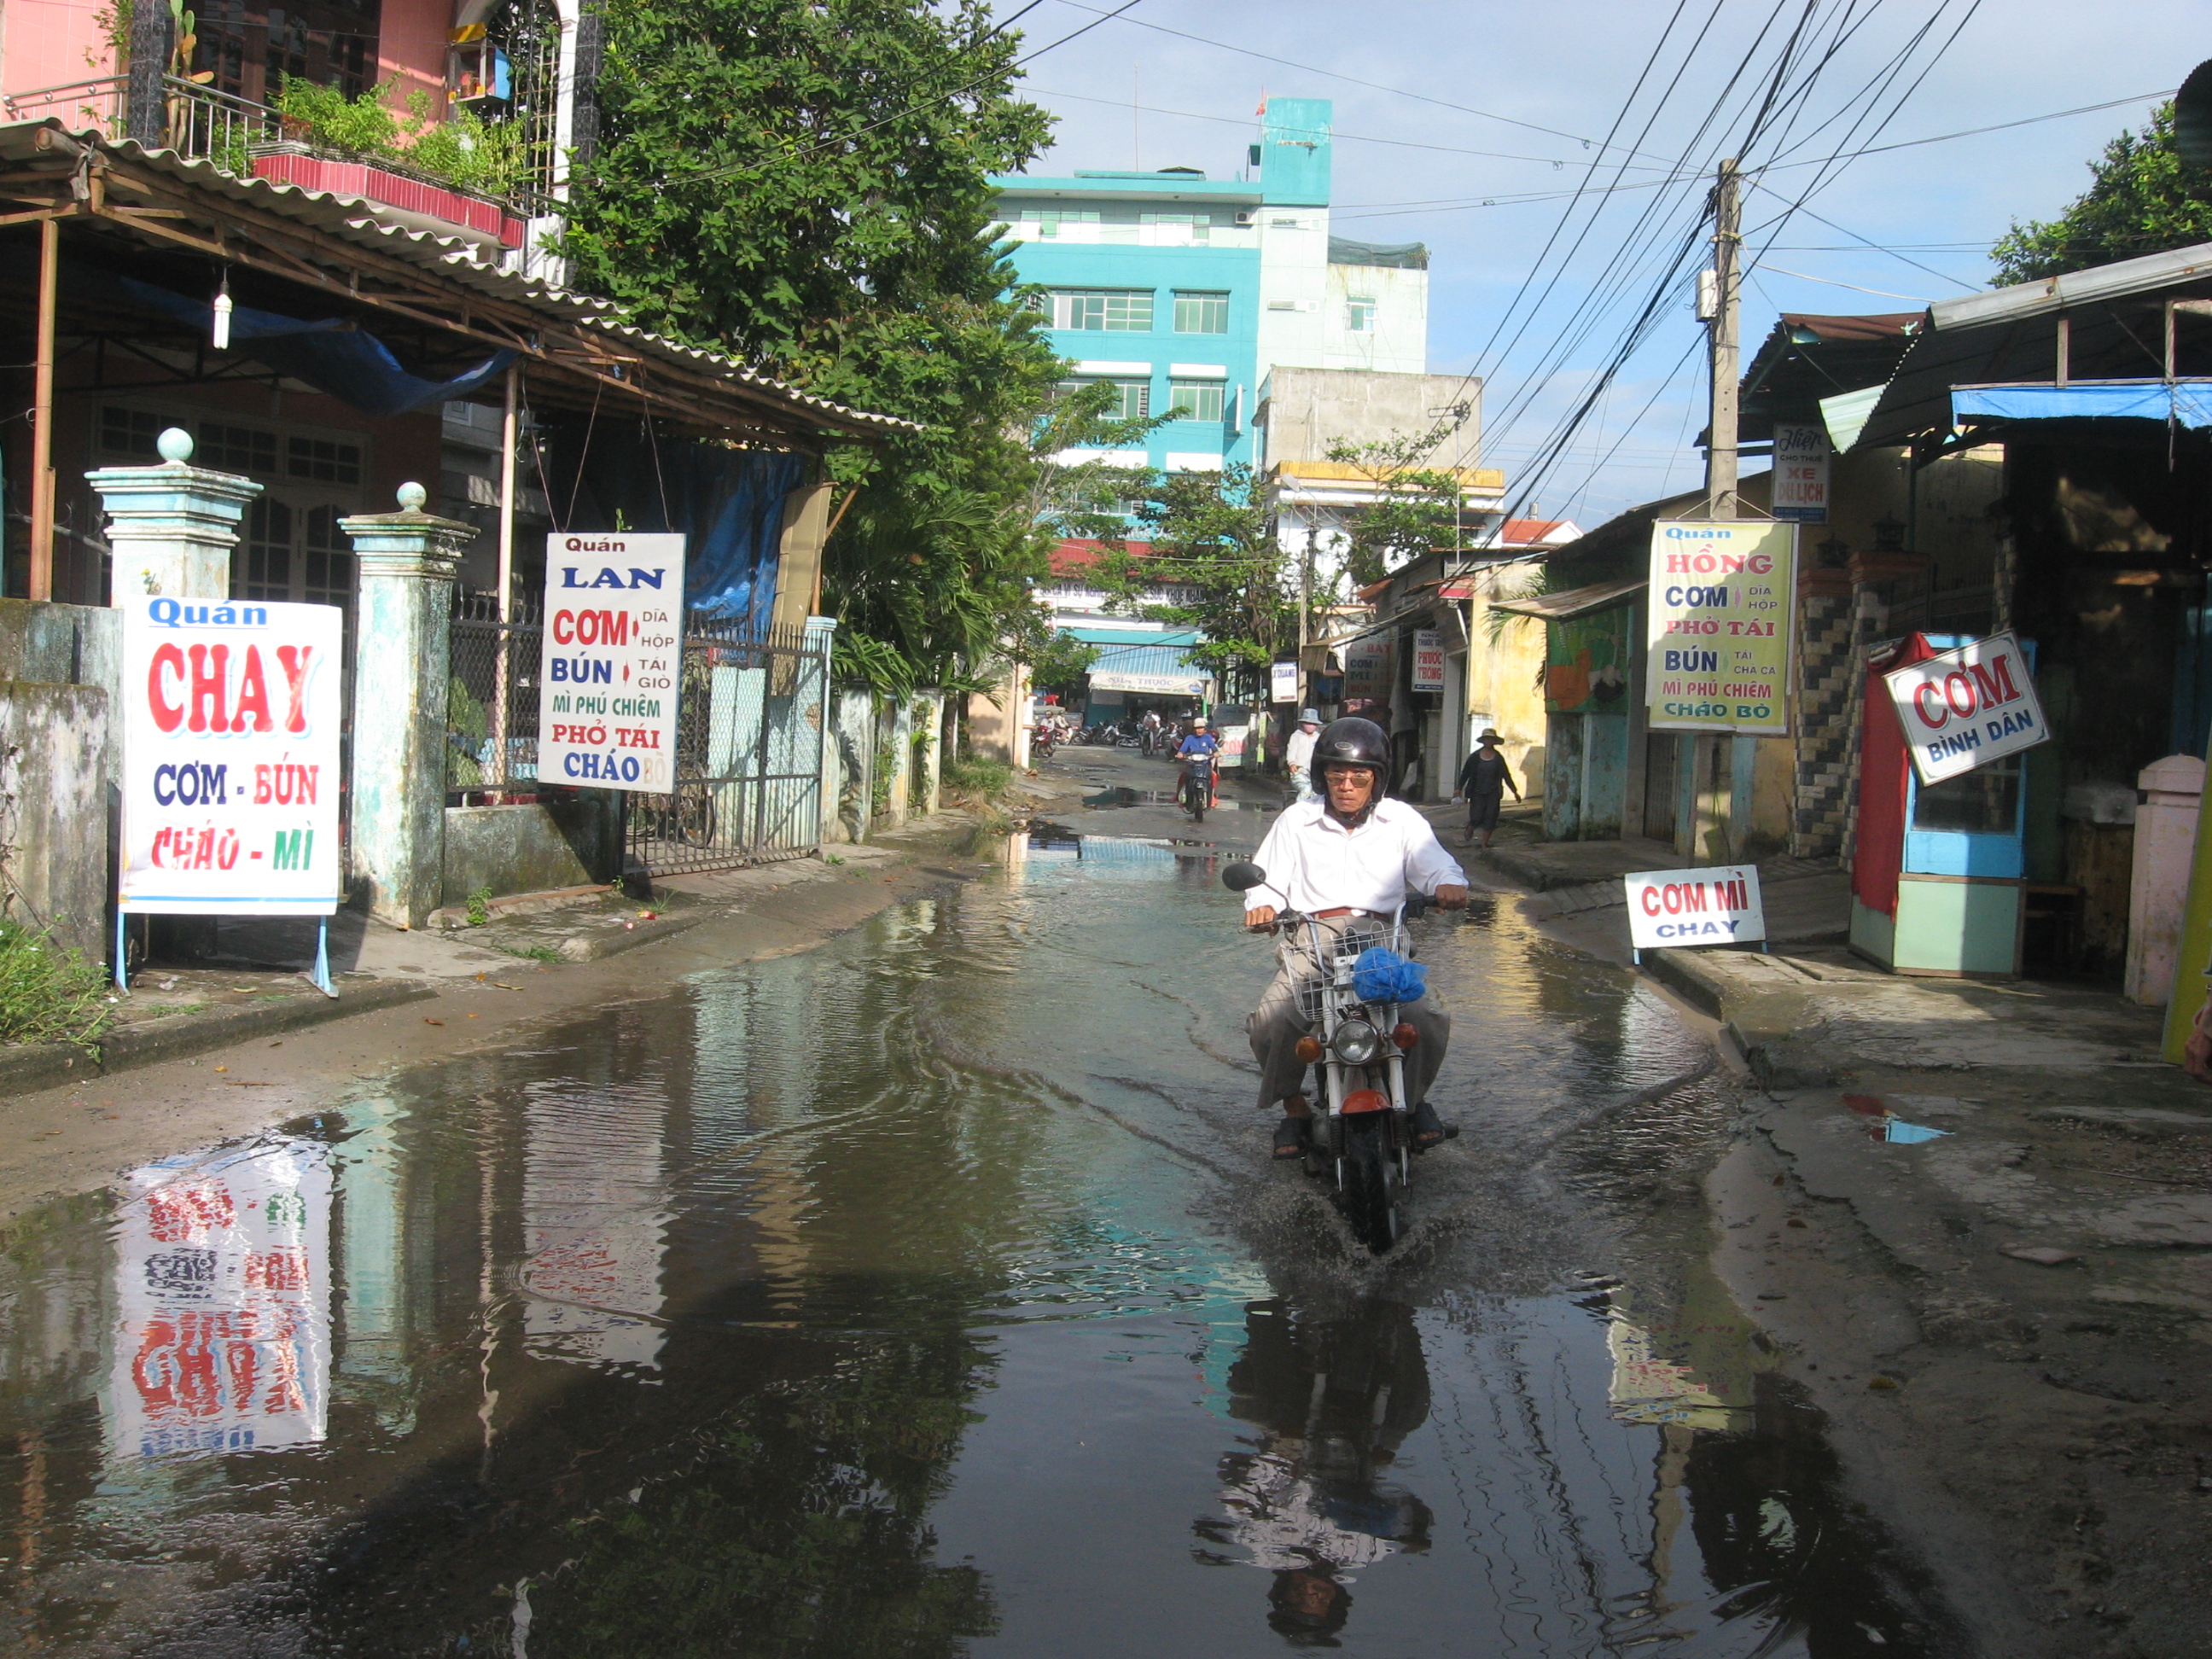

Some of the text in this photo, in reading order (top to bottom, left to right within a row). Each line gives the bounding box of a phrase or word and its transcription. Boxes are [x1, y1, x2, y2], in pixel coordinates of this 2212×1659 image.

[1786, 467, 1816, 480] XE
[566, 537, 626, 552] Quán
[1665, 527, 1732, 540] Quán
[1666, 543, 1774, 575] HỒNG
[561, 568, 667, 590] LAN
[1665, 585, 1729, 608] CƠM
[1749, 599, 1778, 611] HỘP
[148, 597, 267, 628] Quán
[643, 608, 668, 623] DĨA
[553, 608, 628, 646] CƠM
[1665, 615, 1776, 637] PHỞ TÁI
[641, 633, 674, 651] HỘP
[638, 655, 667, 672] TÁI
[1664, 645, 1718, 672] BÚN
[1734, 649, 1752, 661] TÁI
[550, 651, 613, 684] BÚN
[148, 643, 317, 734] CHAY
[638, 674, 671, 689] GIÒ
[1662, 678, 1772, 699] MÌ PHÚ CHIÊM
[1913, 654, 2021, 730] CƠM
[552, 690, 661, 718] MÌ PHÚ CHIÊM
[1664, 701, 1771, 719] CHÁO BÒ
[551, 719, 661, 749] PHỞ TÁI
[1927, 709, 2034, 763] BÌNH DÂN
[564, 748, 640, 783] CHÁO
[154, 760, 228, 806] CƠM
[253, 751, 319, 805] BÚN
[273, 820, 314, 870] MÌ
[1641, 871, 1748, 917] CƠM MÌ
[1656, 920, 1740, 938] CHAY
